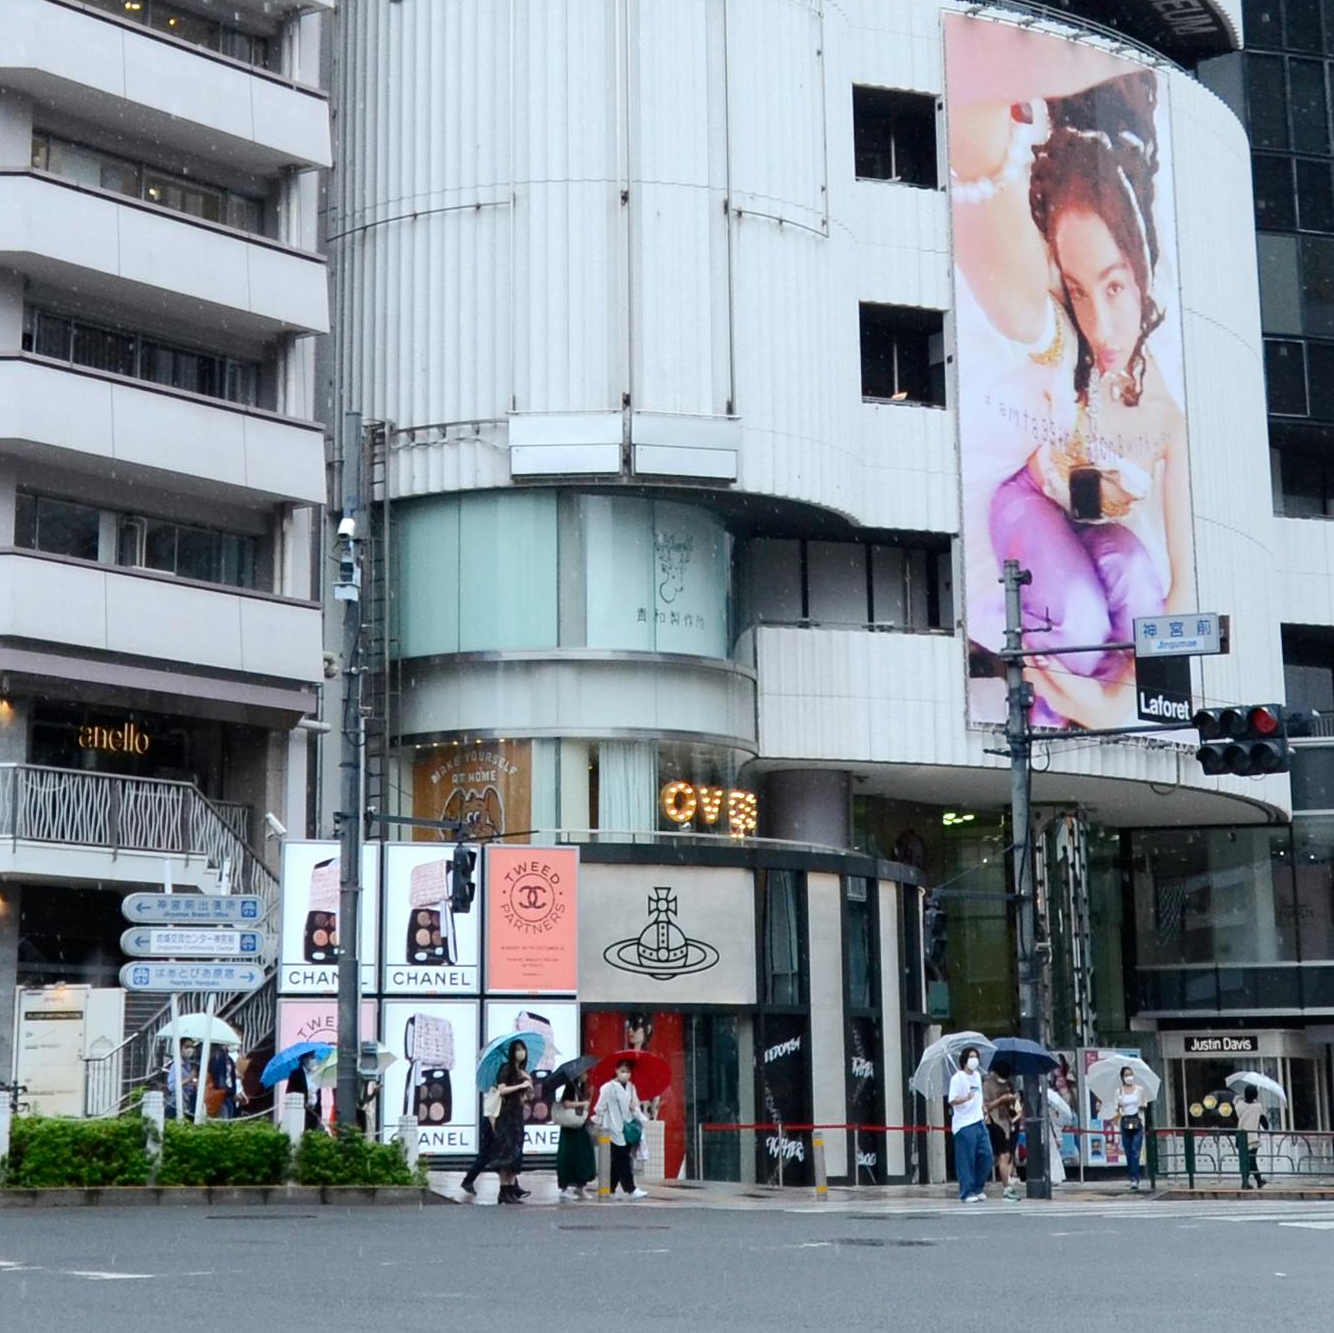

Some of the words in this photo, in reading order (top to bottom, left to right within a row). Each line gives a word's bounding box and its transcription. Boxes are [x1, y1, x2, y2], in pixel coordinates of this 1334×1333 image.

[1143, 619, 1211, 638] 神宮前
[1139, 691, 1191, 721] Laforet
[78, 722, 150, 755] anello
[430, 755, 463, 785] MAKE
[464, 749, 518, 776] YOURSELF
[451, 770, 466, 784] AT
[468, 769, 497, 783] HOME
[503, 860, 561, 886] TWEED
[500, 902, 566, 935] PARTNERS
[288, 970, 368, 986] CHAN
[392, 971, 471, 986] CHANEL
[296, 1015, 338, 1040] TWE
[1189, 1036, 1220, 1052] Justin
[1222, 1036, 1253, 1051] Davis
[391, 1132, 470, 1146] ANEL
[523, 1131, 559, 1145] ANE
